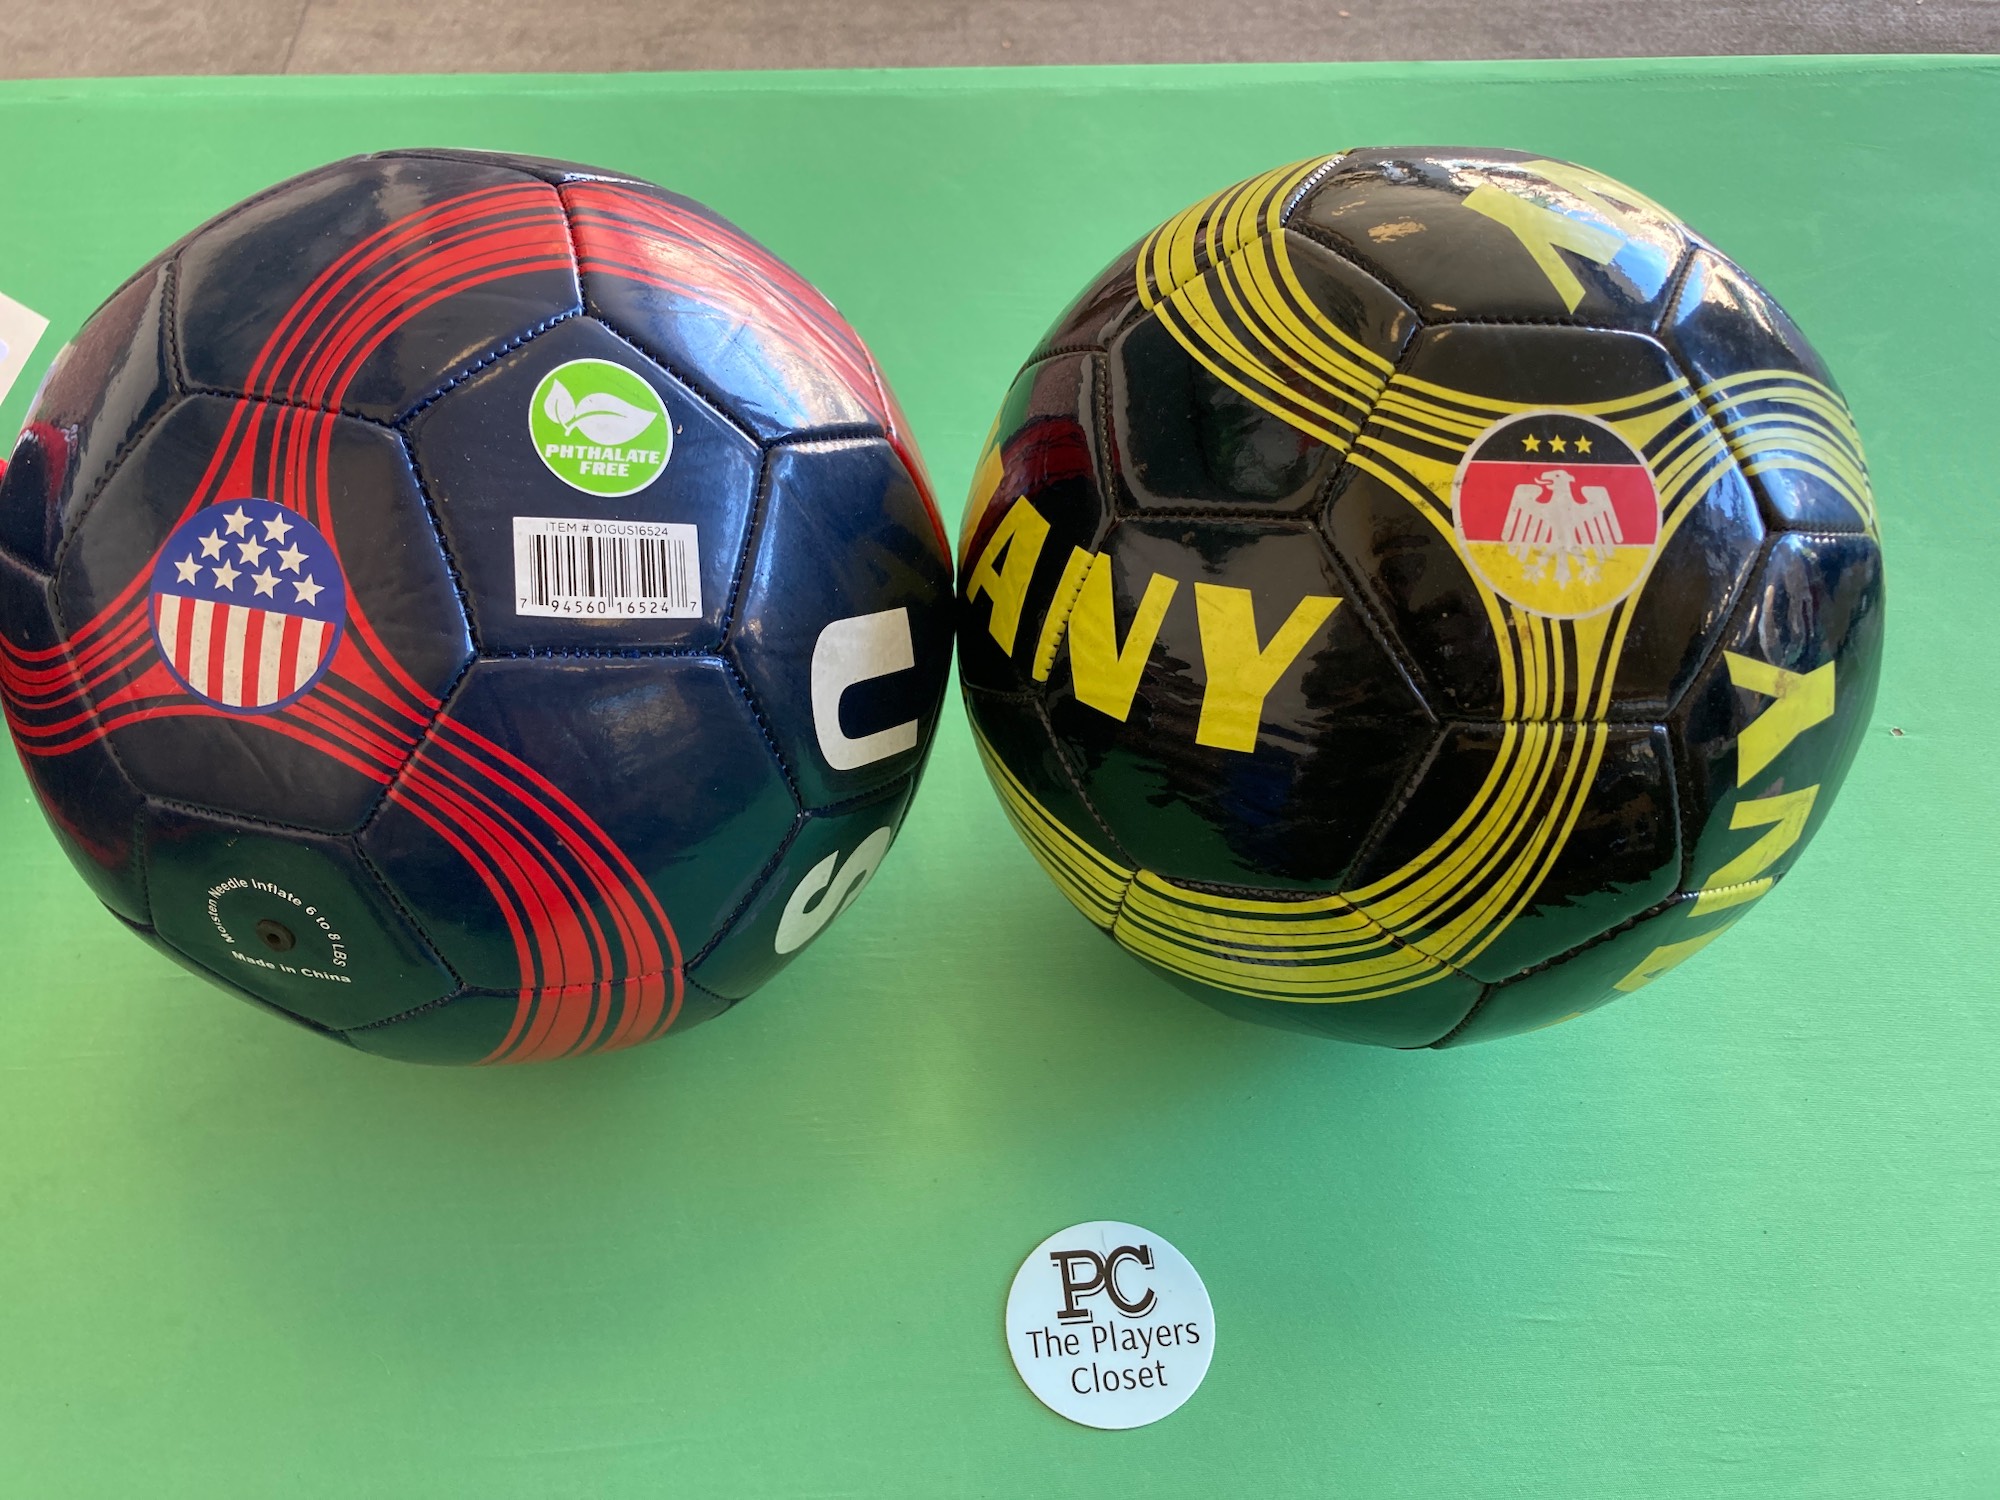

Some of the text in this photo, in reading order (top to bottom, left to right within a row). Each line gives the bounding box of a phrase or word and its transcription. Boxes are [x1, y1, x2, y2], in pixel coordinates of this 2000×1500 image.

[545, 444, 660, 465] PHTHALATE
[580, 461, 630, 477] FREE
[546, 523, 669, 536] ITEM # 01GUS16524
[208, 878, 347, 968] Moisten Needle Inflate 6 to 8 LBS
[231, 950, 351, 983] Made in China
[1050, 1244, 1158, 1326] PC
[1026, 1320, 1200, 1359] The Players
[1071, 1360, 1168, 1394] Closet
